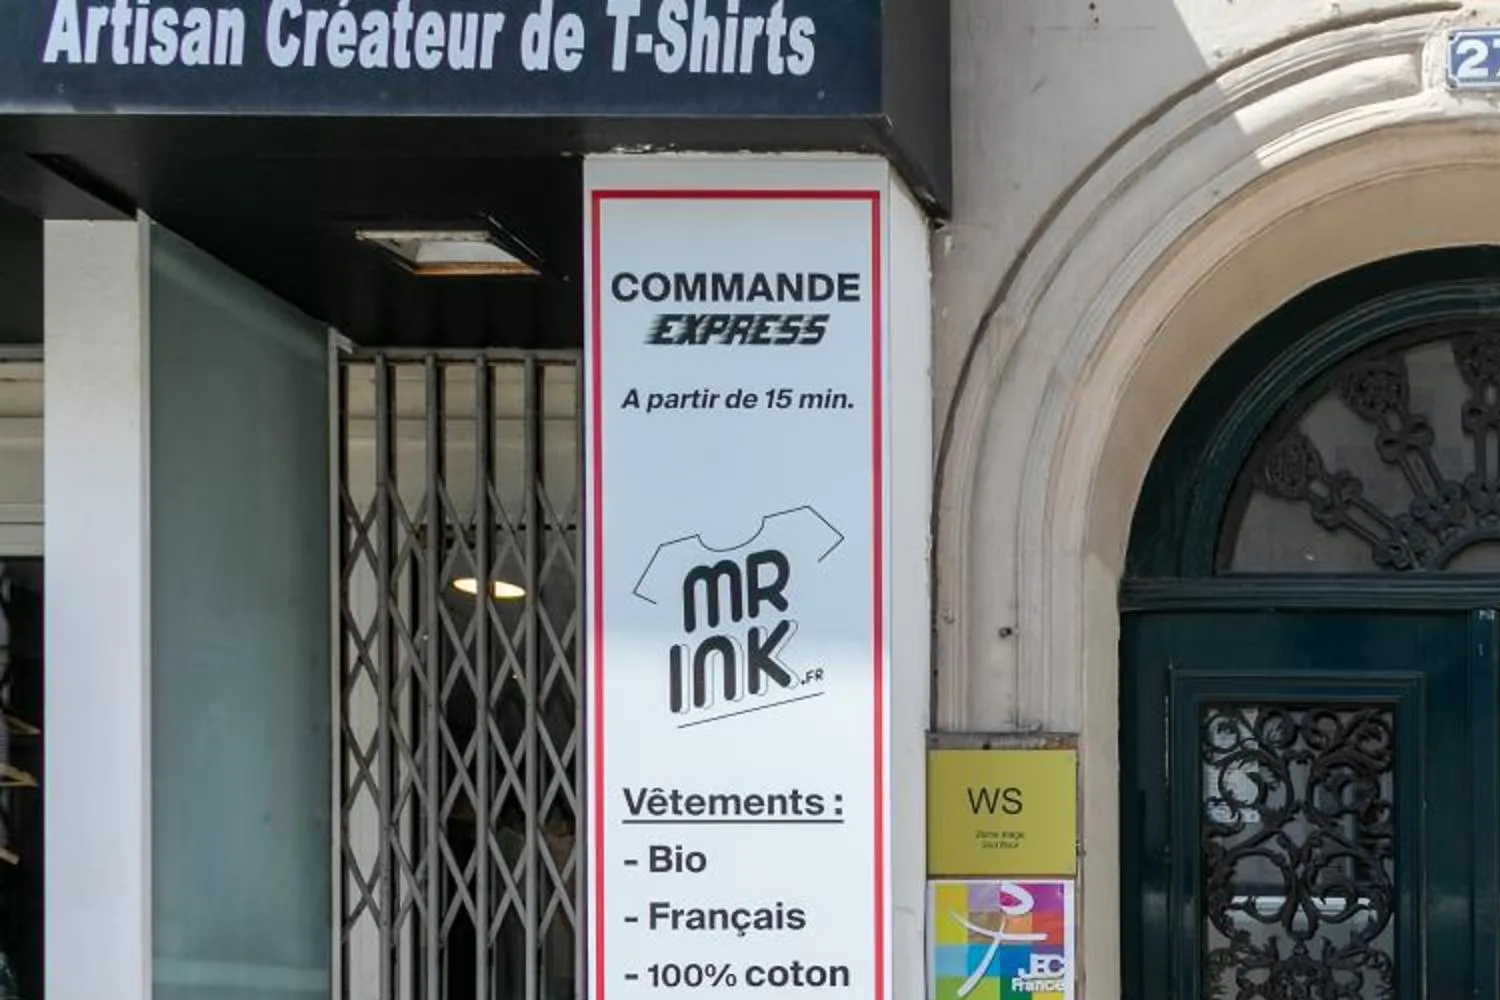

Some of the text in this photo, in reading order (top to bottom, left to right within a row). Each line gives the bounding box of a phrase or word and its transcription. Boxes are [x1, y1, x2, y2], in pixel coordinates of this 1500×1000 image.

[43, 0, 815, 75] Artisan Créateur de T-Shirts
[612, 272, 860, 302] COMMANDE
[647, 314, 829, 345] EXPRESS
[621, 389, 853, 412] A partir de 15 min.
[623, 788, 824, 816] Vêtements
[968, 788, 1022, 814] WS
[650, 846, 706, 873] Bio
[650, 902, 806, 936] Français
[648, 964, 736, 987] 100%
[746, 961, 849, 986] coton
[1017, 954, 1065, 978] JEC
[1012, 977, 1065, 992] France
